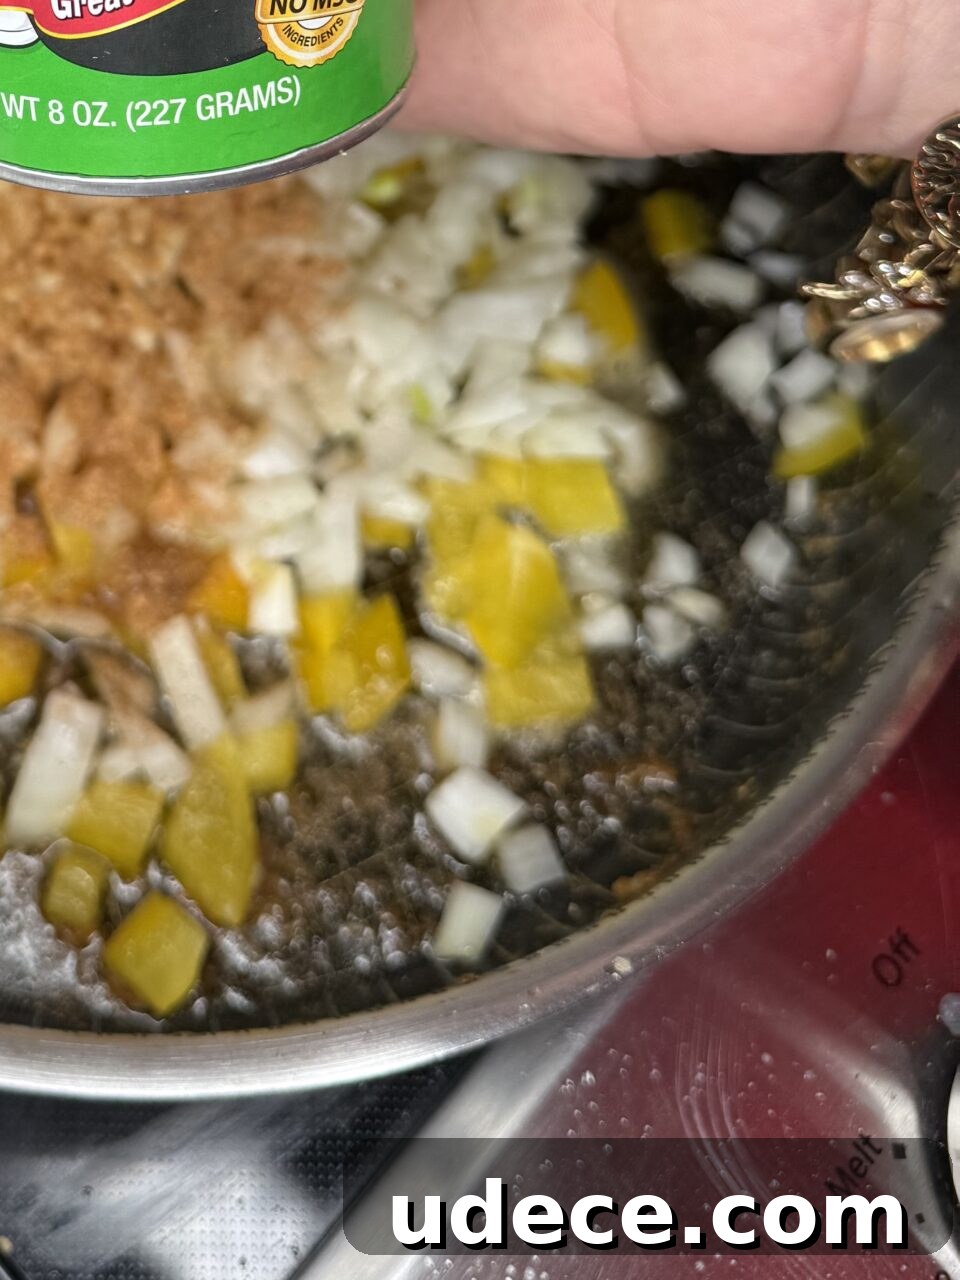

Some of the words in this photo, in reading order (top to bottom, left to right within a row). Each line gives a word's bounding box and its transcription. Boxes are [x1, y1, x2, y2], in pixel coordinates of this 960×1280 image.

[282, 16, 344, 47] INGREDIENTS
[0, 91, 40, 122] WT
[48, 100, 65, 125] 8
[72, 100, 118, 127] OZ.
[125, 97, 187, 133] (227
[195, 73, 302, 122] GRAMS)
[871, 926, 922, 990] Off
